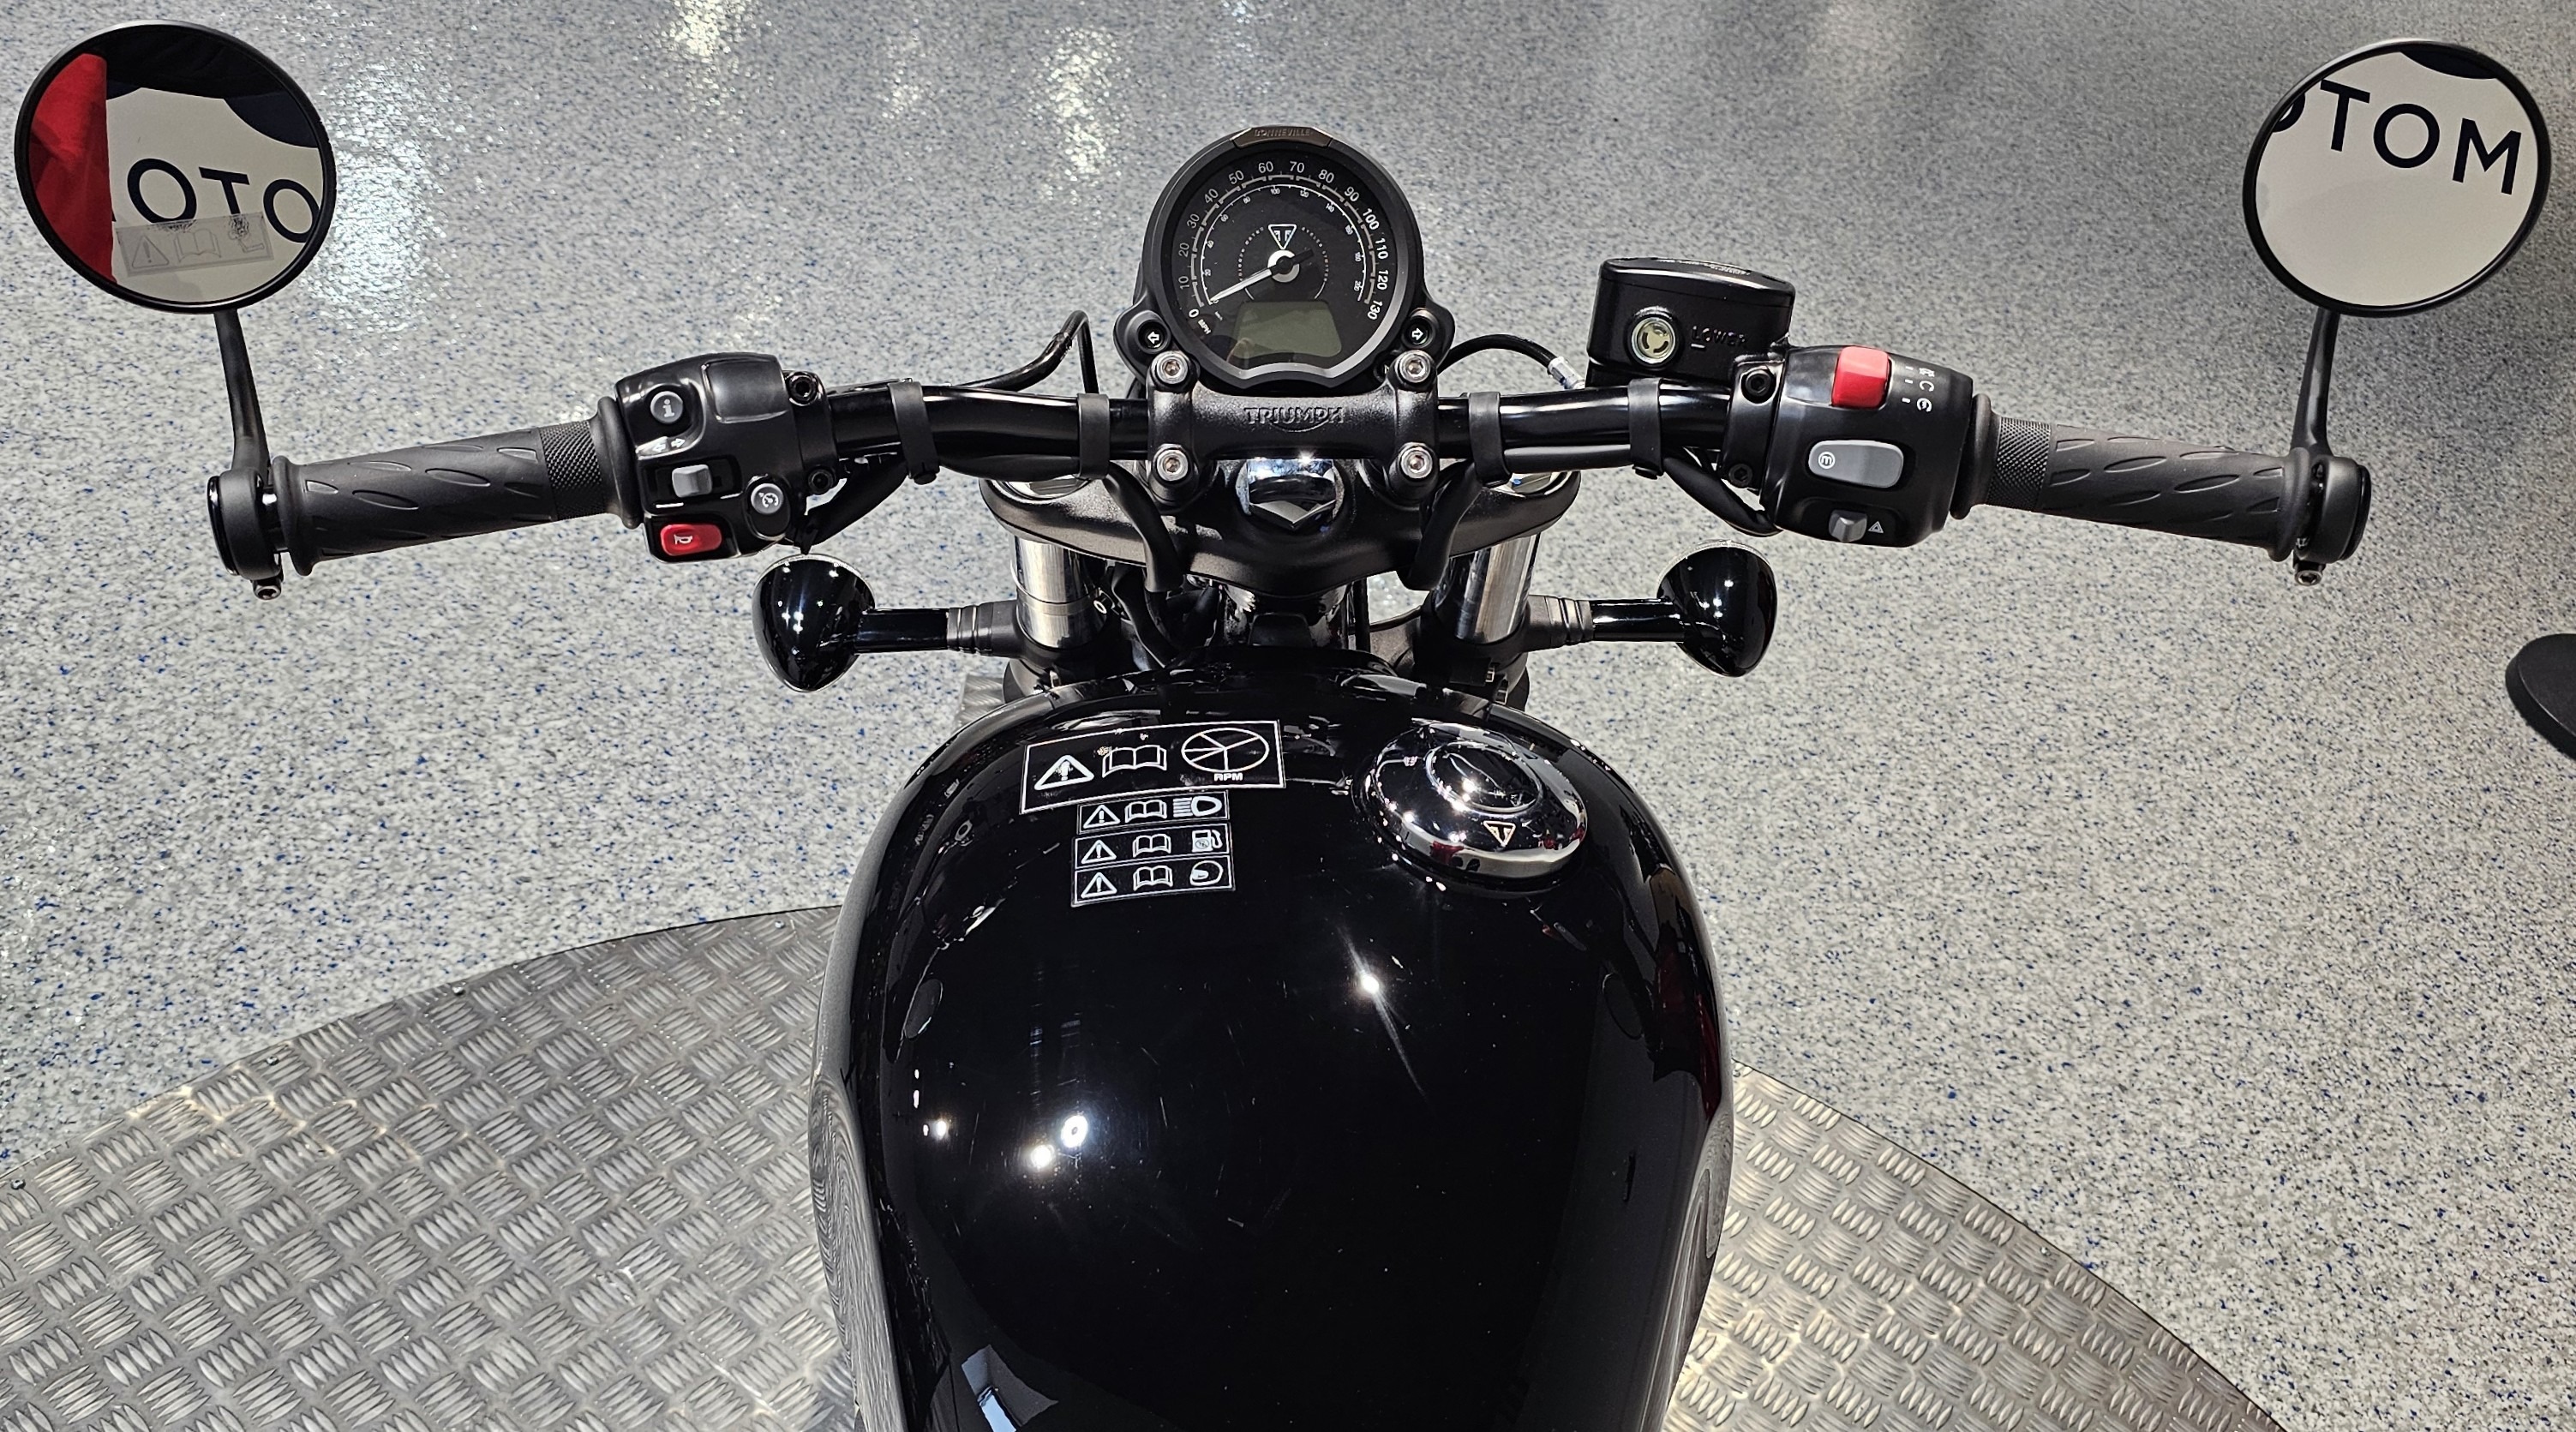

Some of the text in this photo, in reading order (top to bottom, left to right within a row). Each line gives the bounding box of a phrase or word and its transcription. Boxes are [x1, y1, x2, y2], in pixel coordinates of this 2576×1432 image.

[1258, 161, 1273, 174] 60
[1290, 161, 1305, 173] 70
[1229, 171, 1244, 184] 50
[1318, 169, 1334, 183] 80
[112, 158, 321, 243] OTO
[1204, 189, 1219, 204] 40
[1344, 186, 1360, 202] 90
[1186, 213, 1200, 229] 30
[1363, 208, 1380, 230] 100
[1178, 243, 1190, 257] 20
[1375, 238, 1389, 260] 110
[1177, 275, 1190, 290] 10
[1376, 270, 1389, 291] 120
[1189, 309, 1200, 318] 0
[1367, 300, 1383, 321] 130
[1197, 319, 1212, 335] MPH
[1243, 407, 1345, 432] TRIUMPH
[1213, 772, 1243, 781] RPM
